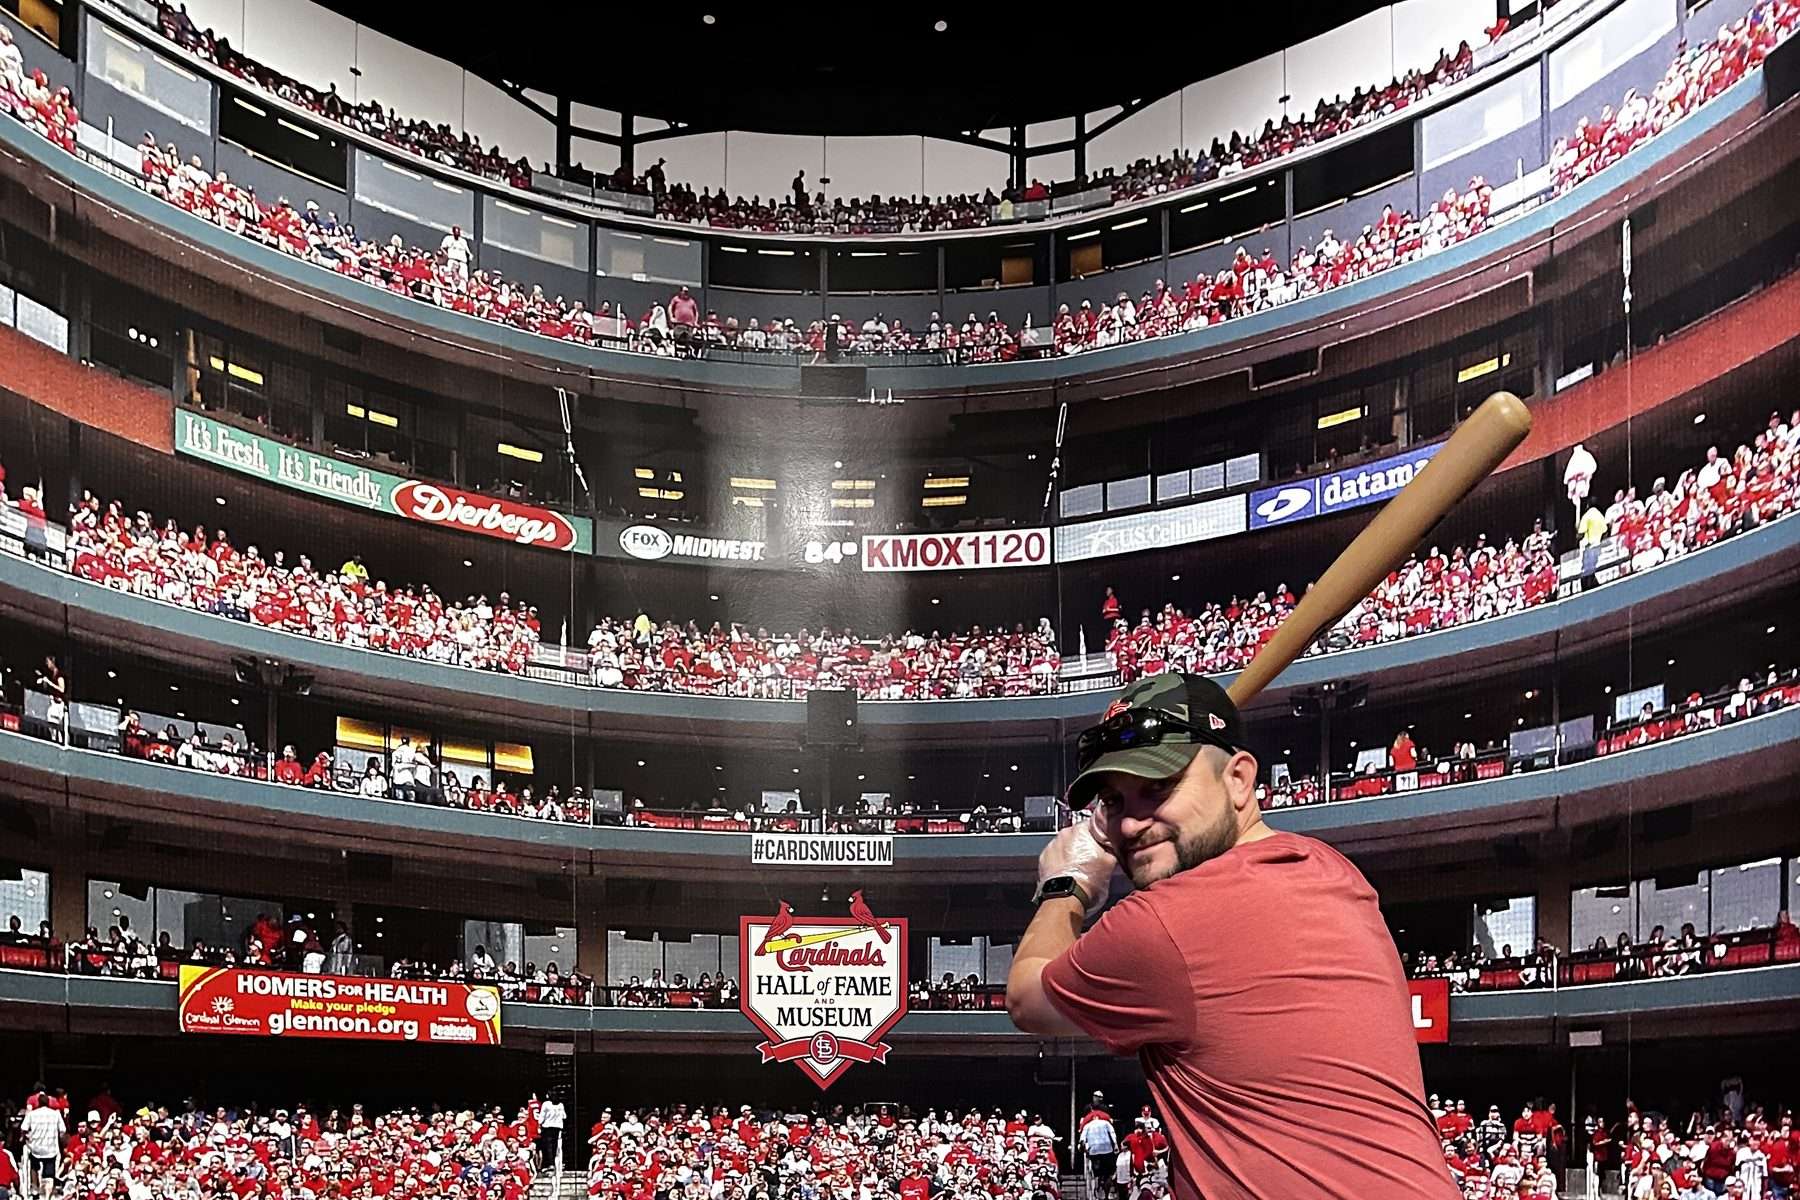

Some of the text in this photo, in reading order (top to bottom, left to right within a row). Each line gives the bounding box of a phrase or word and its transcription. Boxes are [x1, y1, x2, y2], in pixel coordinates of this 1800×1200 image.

[184, 415, 212, 450] It's
[215, 426, 270, 475] Fresh.
[278, 447, 304, 481] It's
[412, 484, 557, 544] Dierbergs
[632, 532, 660, 547] FOX
[754, 839, 892, 862] #CARDSMUSEUM
[776, 934, 886, 972] Cardinals
[237, 974, 447, 1005] HOMERS FOR HEALTH
[756, 975, 892, 996] HALL of FAME
[185, 1011, 260, 1026] Cardinal Glennon
[290, 999, 396, 1016] Make your pledge
[776, 1007, 872, 1027] MUSEUM
[268, 1009, 419, 1040] glennon.org
